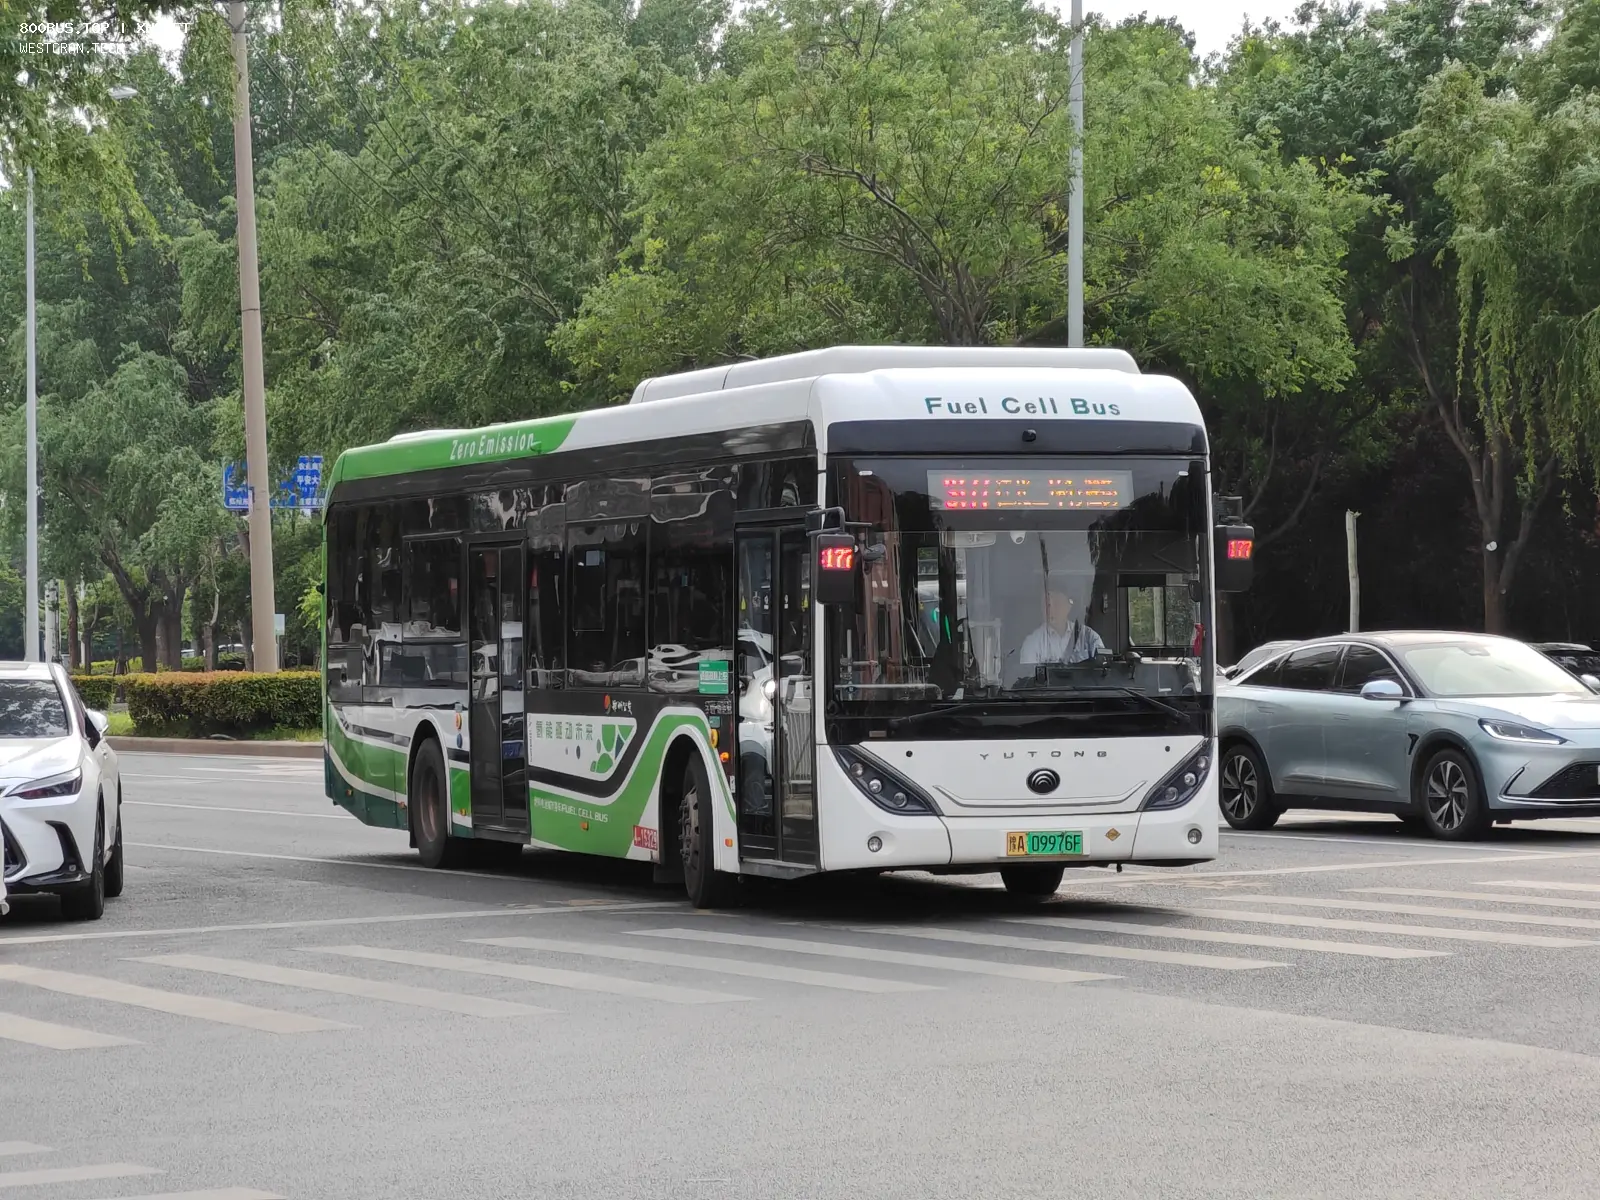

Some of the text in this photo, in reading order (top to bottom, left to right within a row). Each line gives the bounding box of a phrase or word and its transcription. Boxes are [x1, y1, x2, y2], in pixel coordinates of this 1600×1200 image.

[924, 397, 1121, 416] Fuel Cell Bus
[450, 430, 534, 461] Zero Emission
[825, 547, 852, 569] 177
[1227, 540, 1252, 559] 177
[979, 750, 1107, 761] YUTONG
[594, 811, 609, 824] BUS
